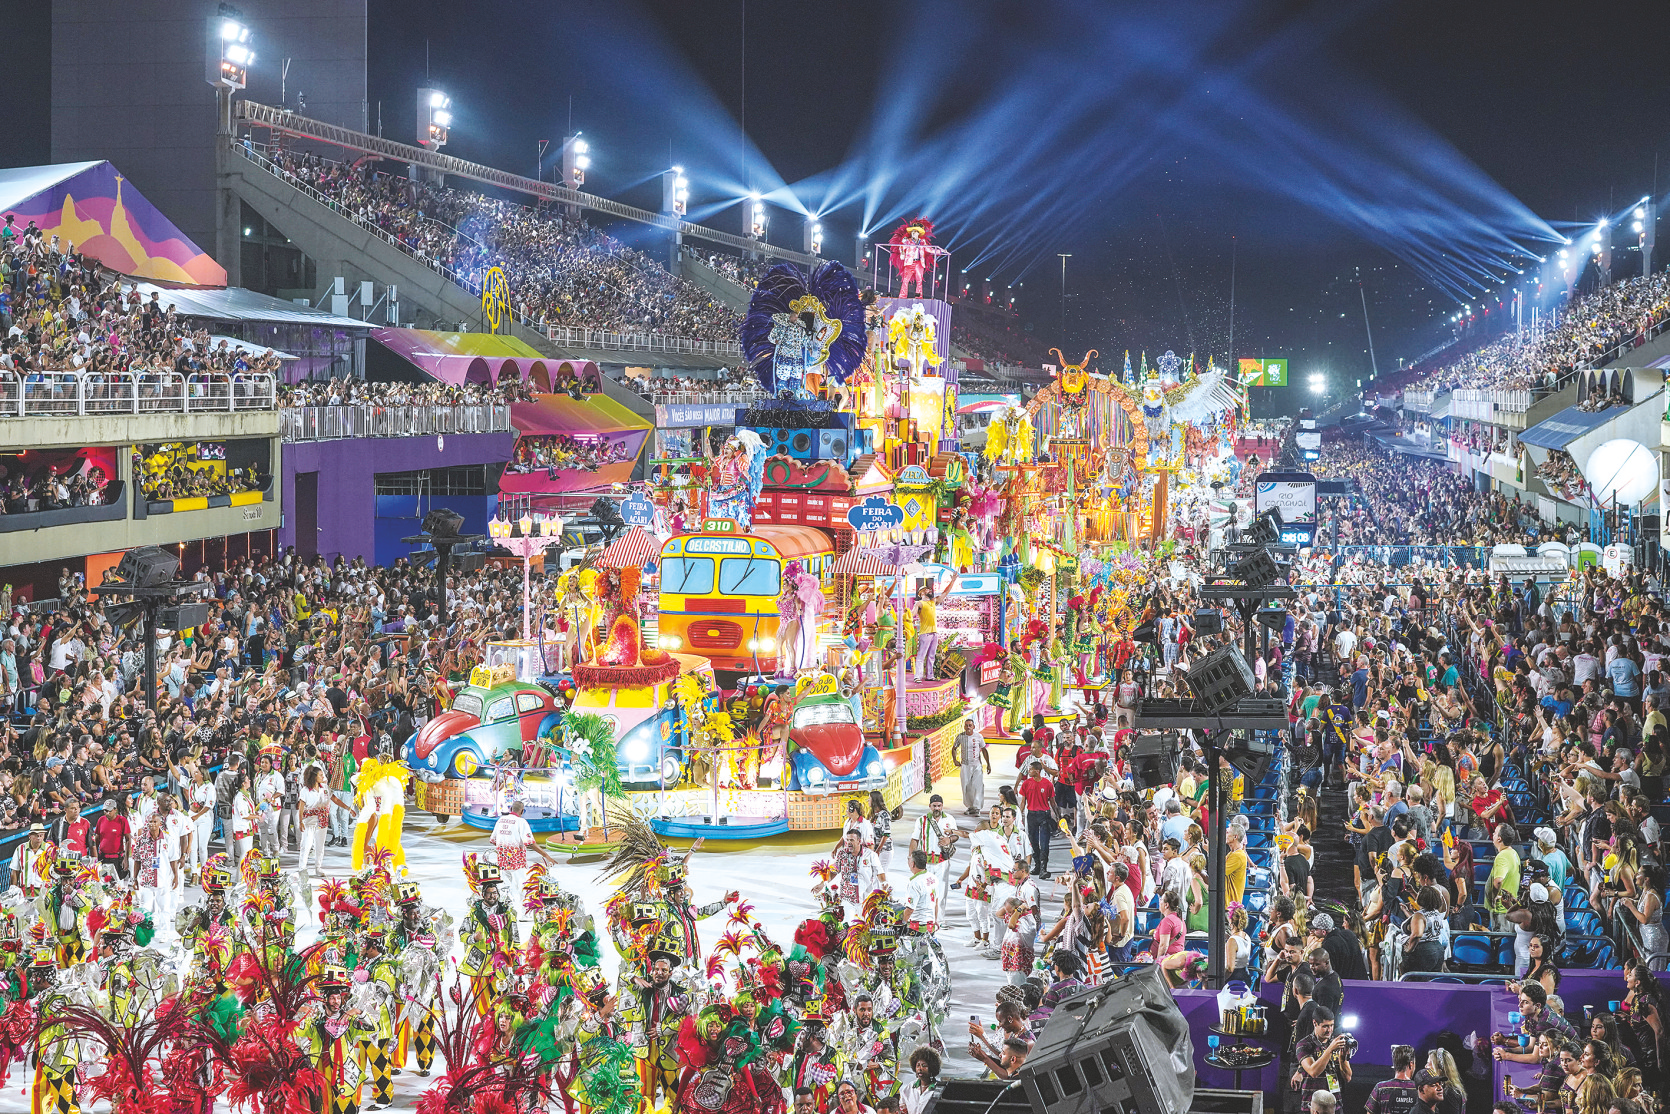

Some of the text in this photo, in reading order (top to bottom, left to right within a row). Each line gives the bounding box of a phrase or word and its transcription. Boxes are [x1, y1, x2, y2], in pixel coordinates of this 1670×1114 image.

[704, 408, 720, 421] MAIOR
[721, 405, 735, 422] ATRAÇ
[904, 470, 924, 480] ZECA
[629, 502, 647, 511] FEIRA
[862, 507, 893, 516] FEIRA
[629, 515, 648, 525] ACARI
[706, 522, 730, 530] 310
[860, 521, 892, 530] ACARI
